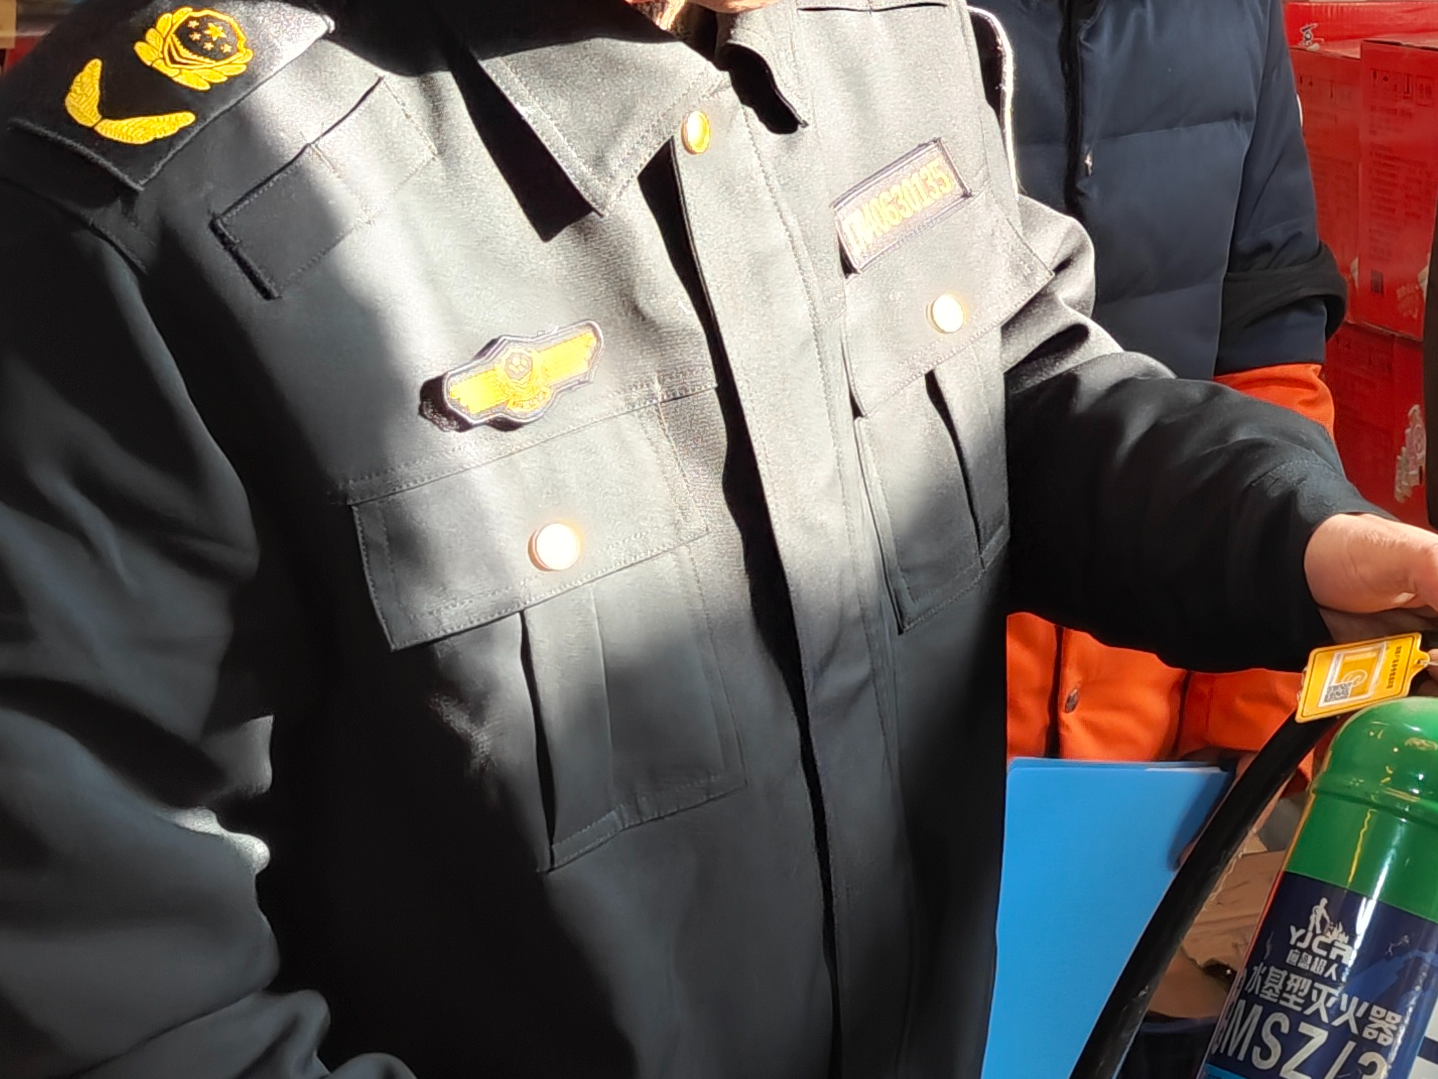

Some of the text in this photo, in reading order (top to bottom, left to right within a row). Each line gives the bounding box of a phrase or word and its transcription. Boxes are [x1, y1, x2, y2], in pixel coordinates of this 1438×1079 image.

[1245, 961, 1403, 1047] 水基型灭火器
